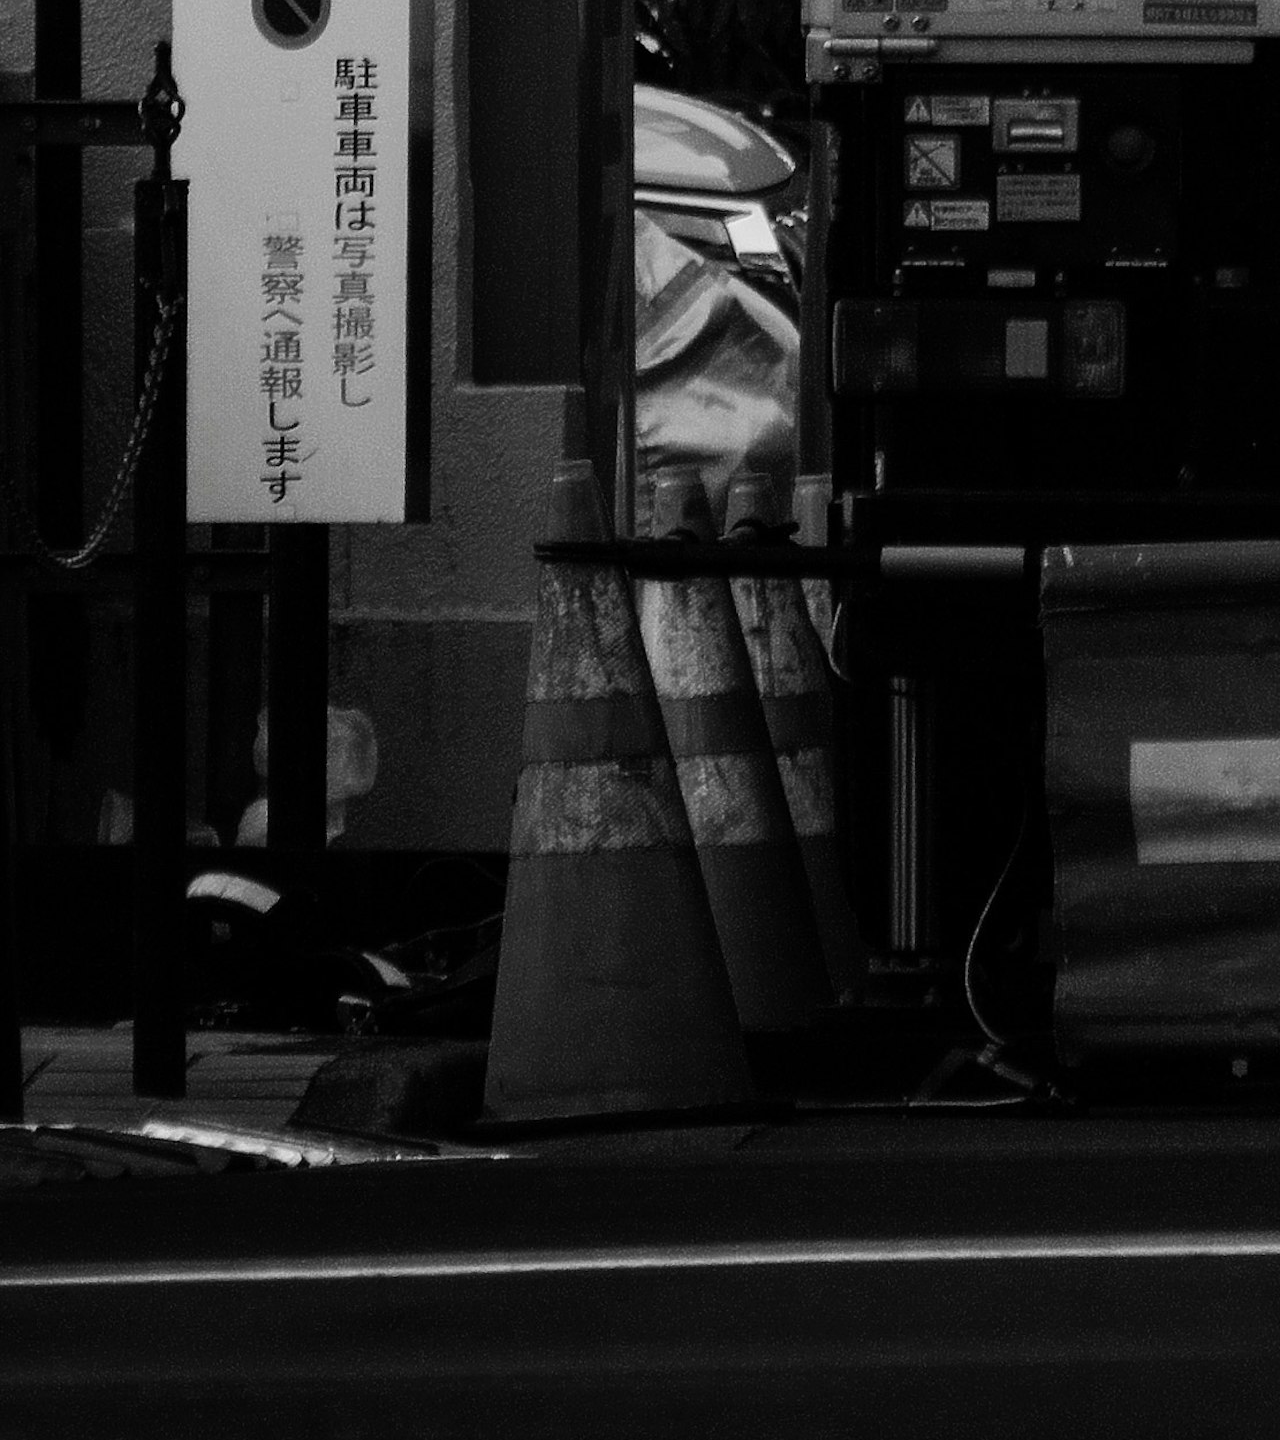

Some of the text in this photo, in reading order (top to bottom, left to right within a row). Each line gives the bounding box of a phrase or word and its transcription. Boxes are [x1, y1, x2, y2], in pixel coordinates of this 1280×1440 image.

[259, 235, 304, 503] 警察へ通報します
[332, 57, 378, 408] 駐車車両は写真撮影し
